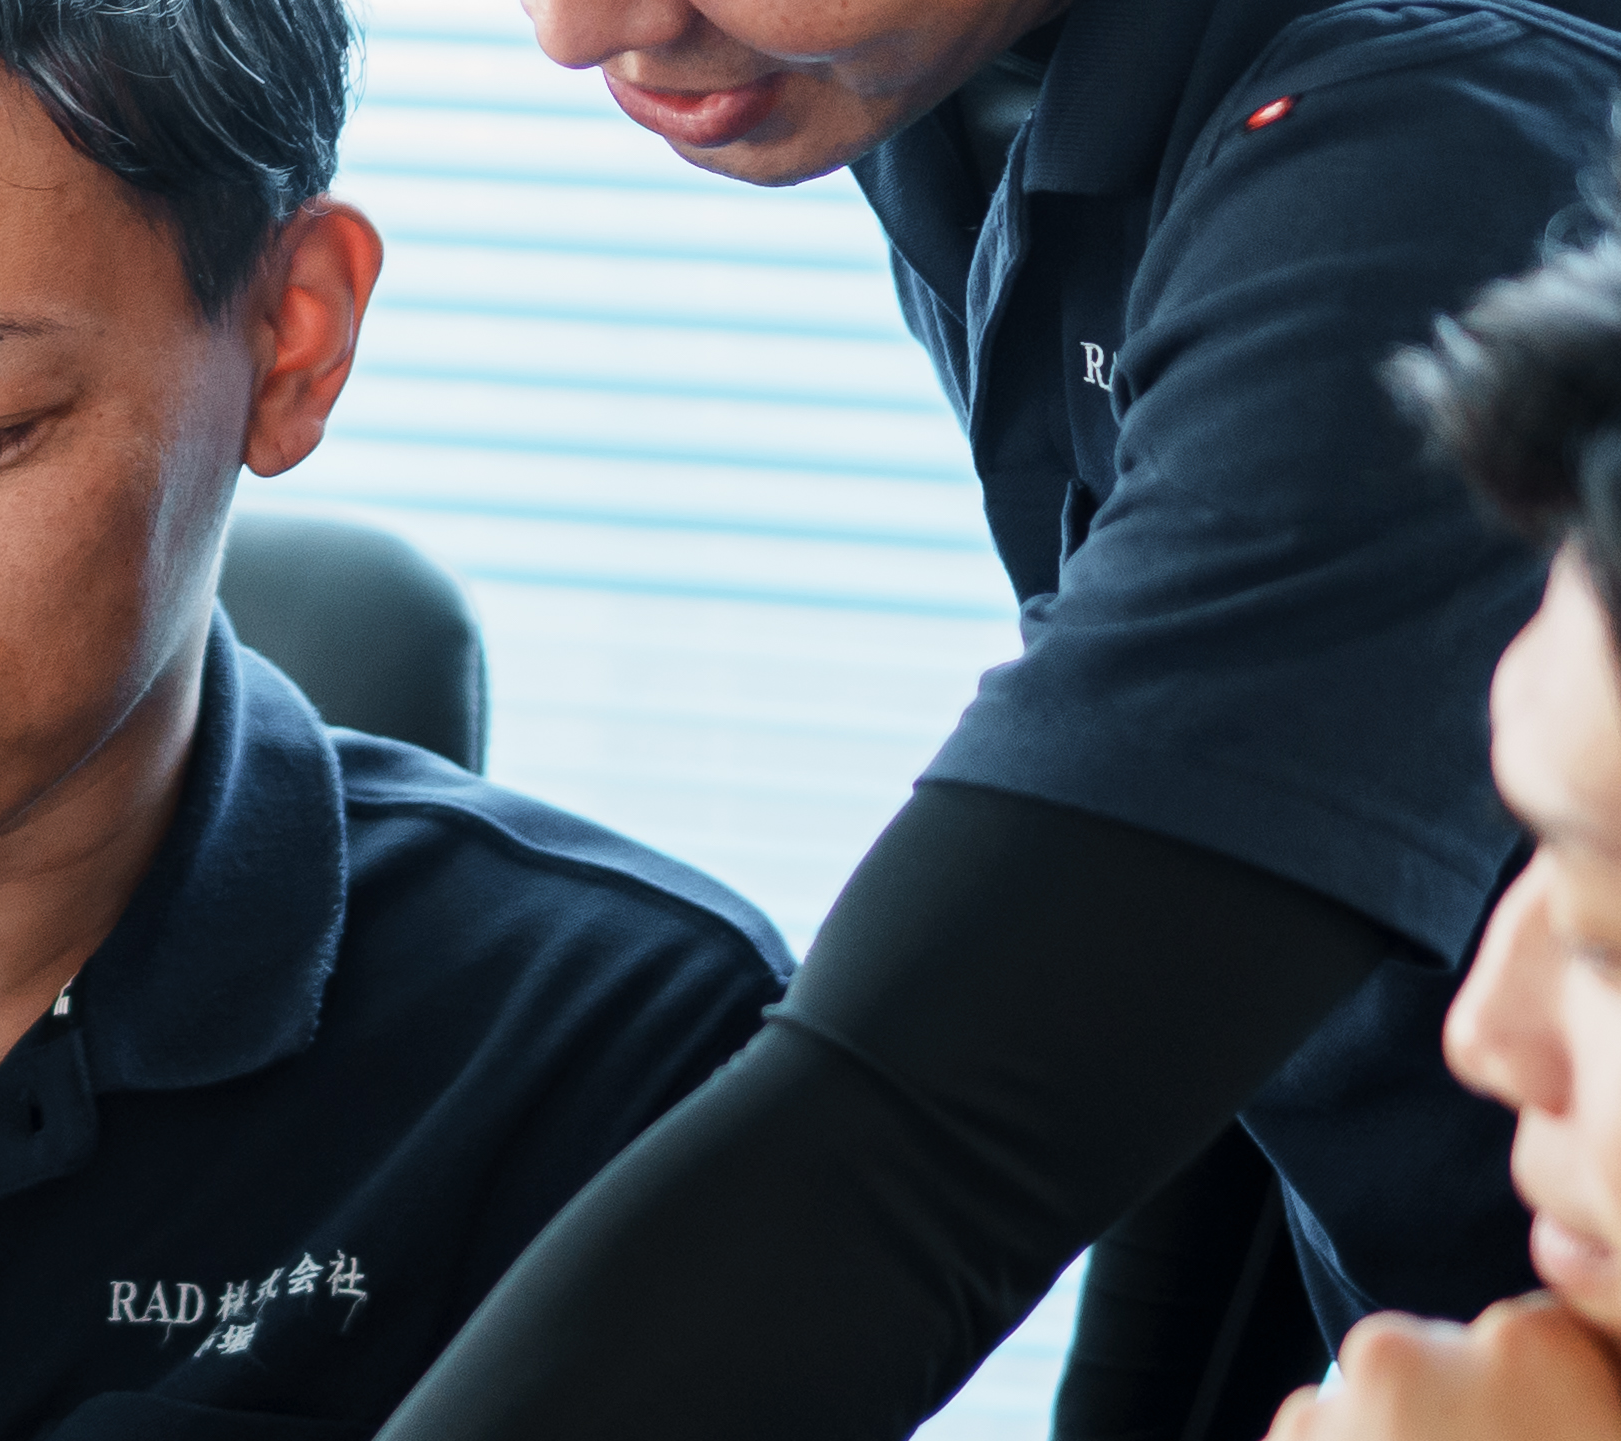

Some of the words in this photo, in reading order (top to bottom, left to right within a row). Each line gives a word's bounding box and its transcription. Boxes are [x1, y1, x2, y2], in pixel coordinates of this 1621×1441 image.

[108, 1280, 205, 1325] RAD
[215, 1249, 367, 1321] 株式会社
